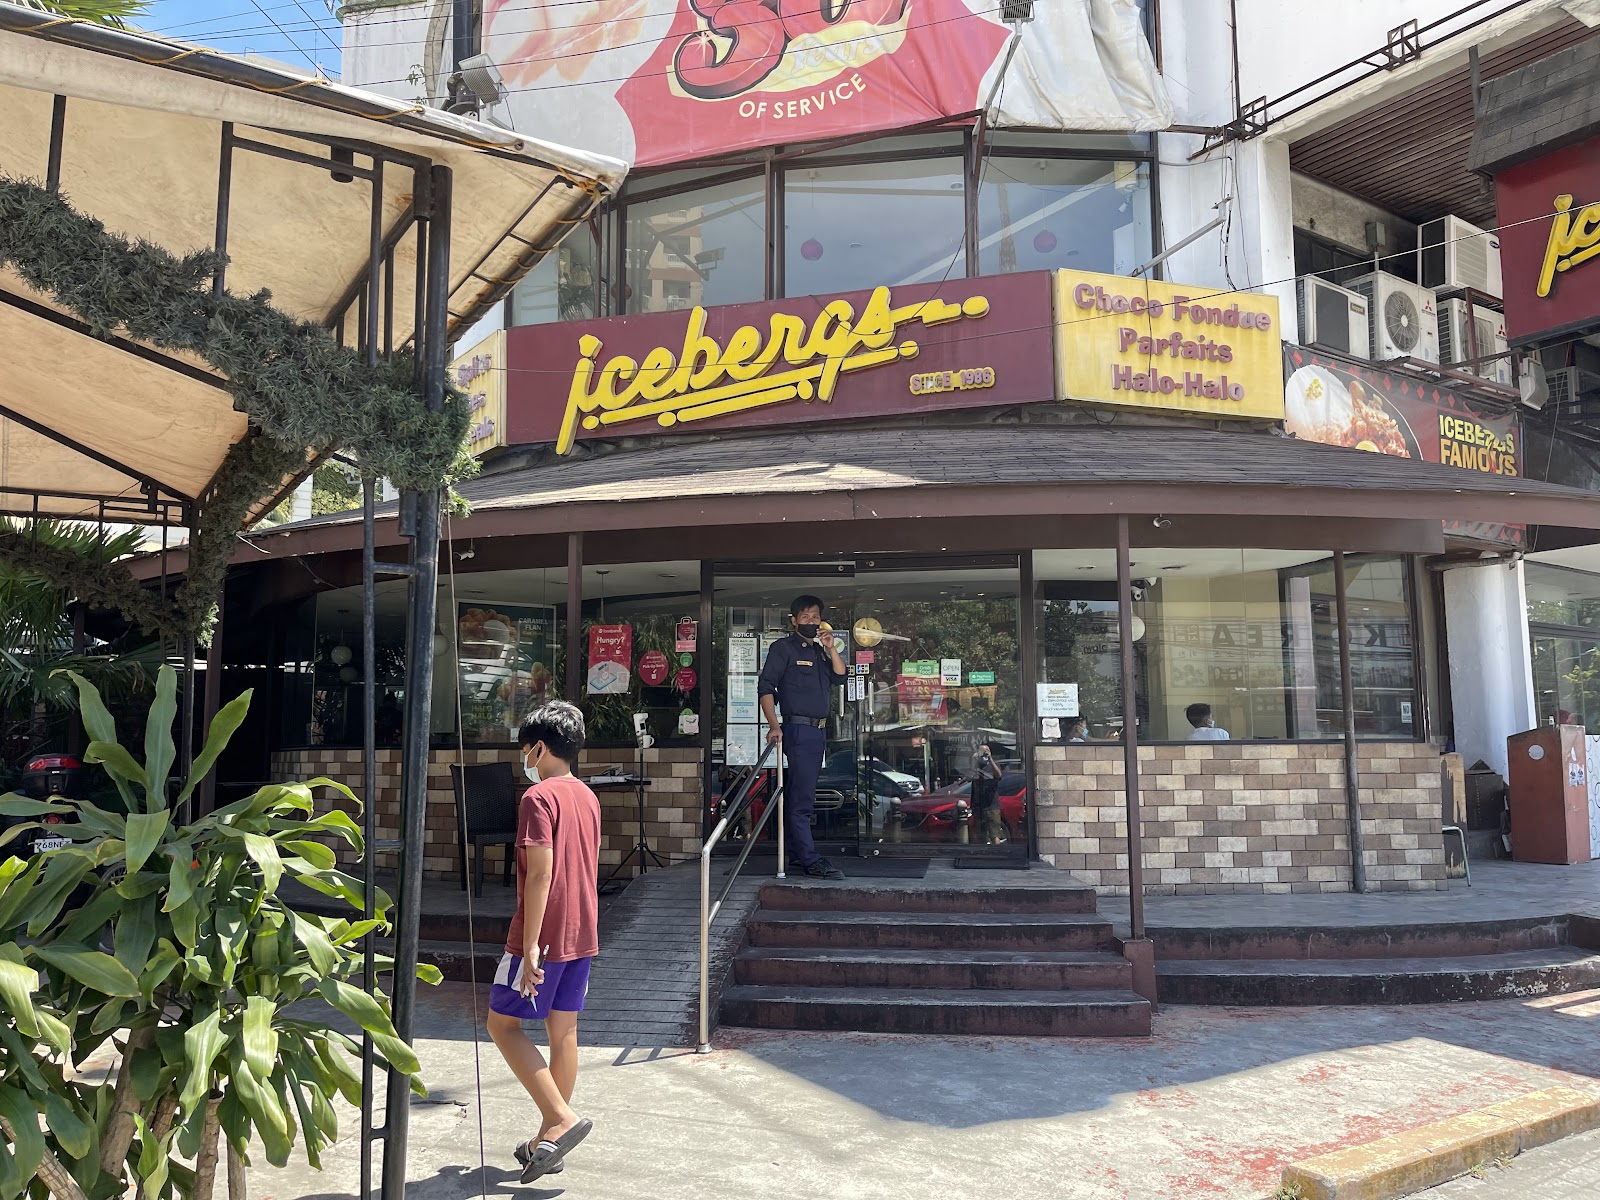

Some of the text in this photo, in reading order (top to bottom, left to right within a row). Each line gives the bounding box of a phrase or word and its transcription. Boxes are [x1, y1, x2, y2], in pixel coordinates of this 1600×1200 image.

[788, 34, 886, 75] Years
[739, 73, 867, 119] OF SERVICE
[1074, 283, 1271, 331] Choco Fondue
[1119, 327, 1233, 363] Parfaits
[556, 286, 962, 455] icebergs
[911, 368, 993, 391] SINCE 1986
[1111, 364, 1245, 401] Halo-Halo
[1440, 438, 1517, 477] FAMOUS
[518, 617, 549, 625] CARAMEL
[596, 636, 625, 646] Hungry?
